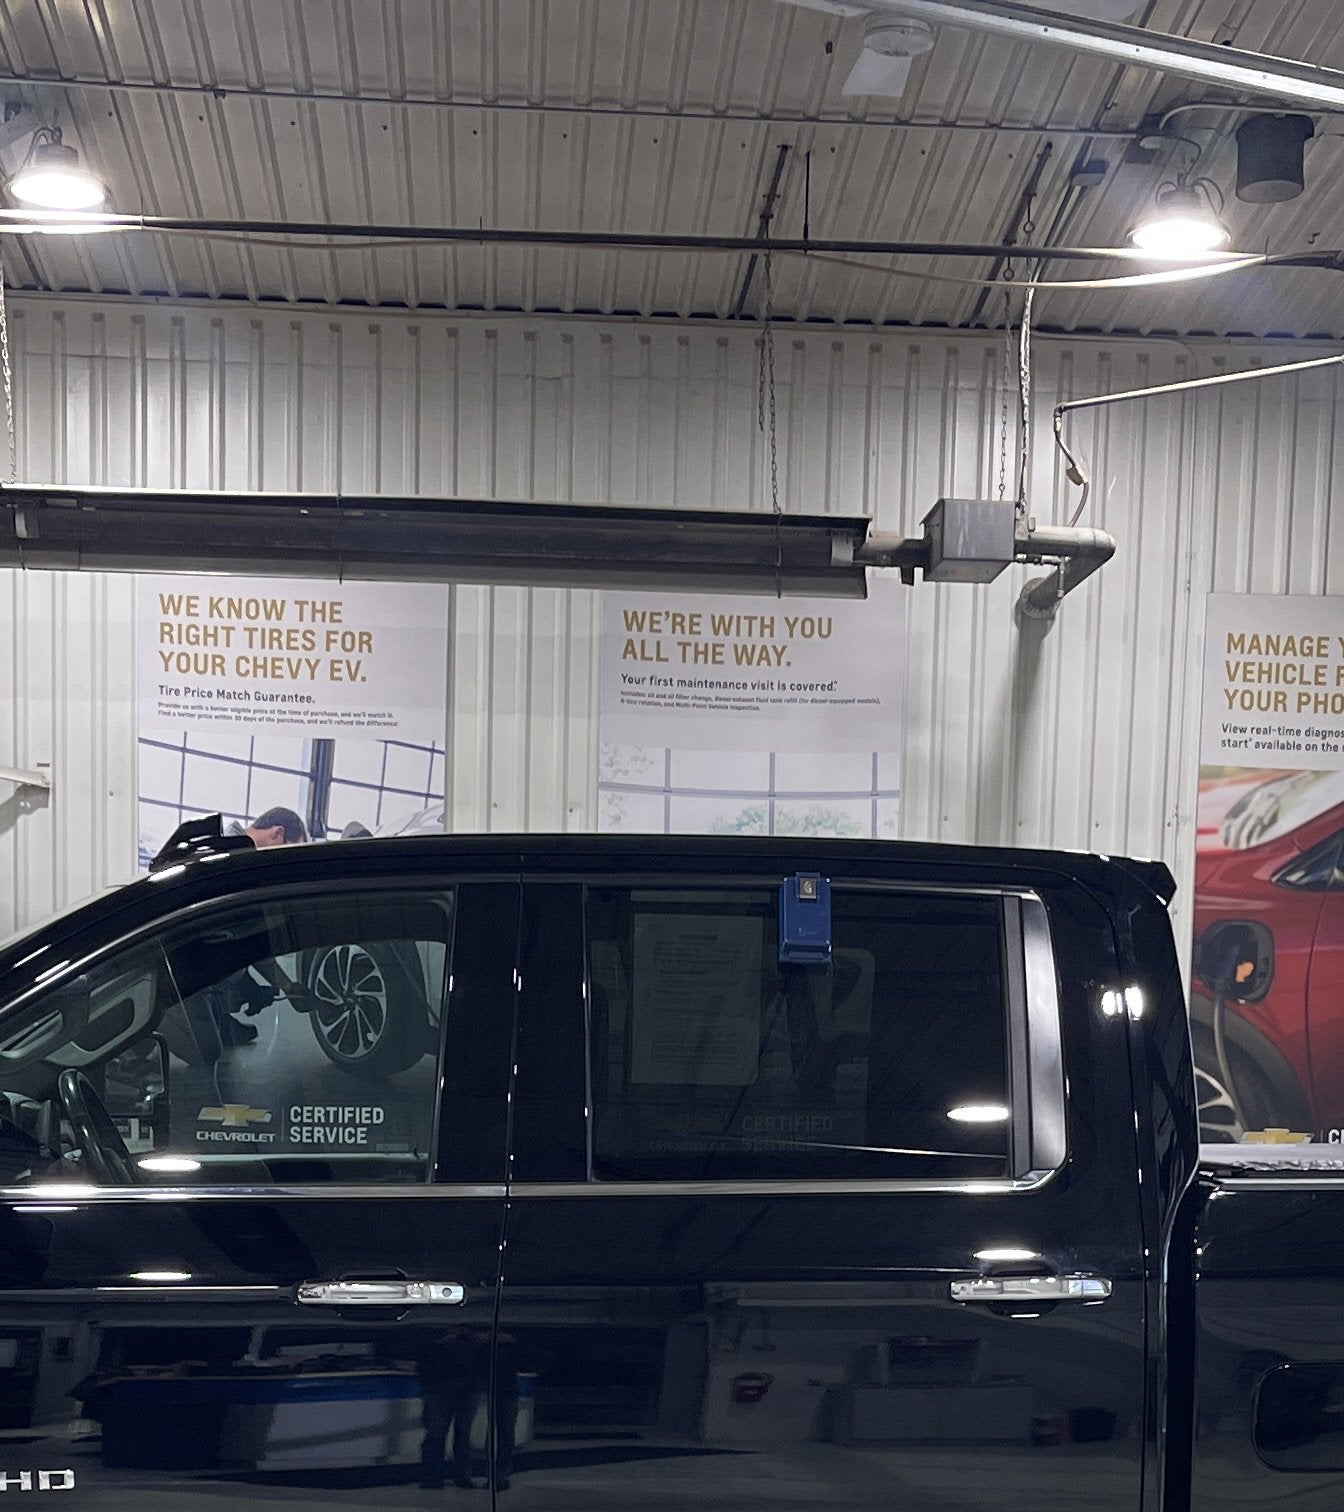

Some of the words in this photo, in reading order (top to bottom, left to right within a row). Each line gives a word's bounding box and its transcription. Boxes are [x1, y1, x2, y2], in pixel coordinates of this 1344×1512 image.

[159, 593, 199, 617] WE
[208, 597, 286, 621] KNOW
[294, 601, 343, 623] THE
[623, 610, 702, 636] WE'RE
[711, 614, 775, 638] WITH
[784, 616, 833, 639] YOU
[159, 622, 235, 648] RIGHT
[243, 627, 316, 652] TIRES
[325, 630, 374, 653] FOR
[1226, 632, 1330, 658] MANAGE
[622, 639, 669, 662] ALL
[677, 641, 725, 665] THE
[733, 643, 792, 667] WAY.
[158, 650, 226, 677] YOUR
[235, 655, 321, 680] CHEVY
[329, 659, 367, 682] EV.
[1225, 660, 1327, 686] VEHICLE
[621, 673, 646, 685] Your
[649, 675, 674, 687] first
[677, 678, 748, 690] maintenance
[751, 680, 774, 691] visit
[777, 680, 786, 691] is
[159, 685, 181, 697] Tire
[184, 687, 213, 699] Price
[217, 689, 251, 700] Match
[254, 691, 315, 704] Guarantee.
[1224, 688, 1287, 713] YOUR
[1222, 722, 1247, 734] View
[1250, 726, 1301, 737] real-time
[1254, 739, 1302, 751] available
[1305, 743, 1318, 751] on
[1321, 742, 1339, 752] the
[289, 1106, 385, 1125] CERTIFIED
[741, 1115, 833, 1132] CERTIFIED
[195, 1131, 276, 1143] CHEVROLET
[289, 1126, 368, 1145] SERVICE
